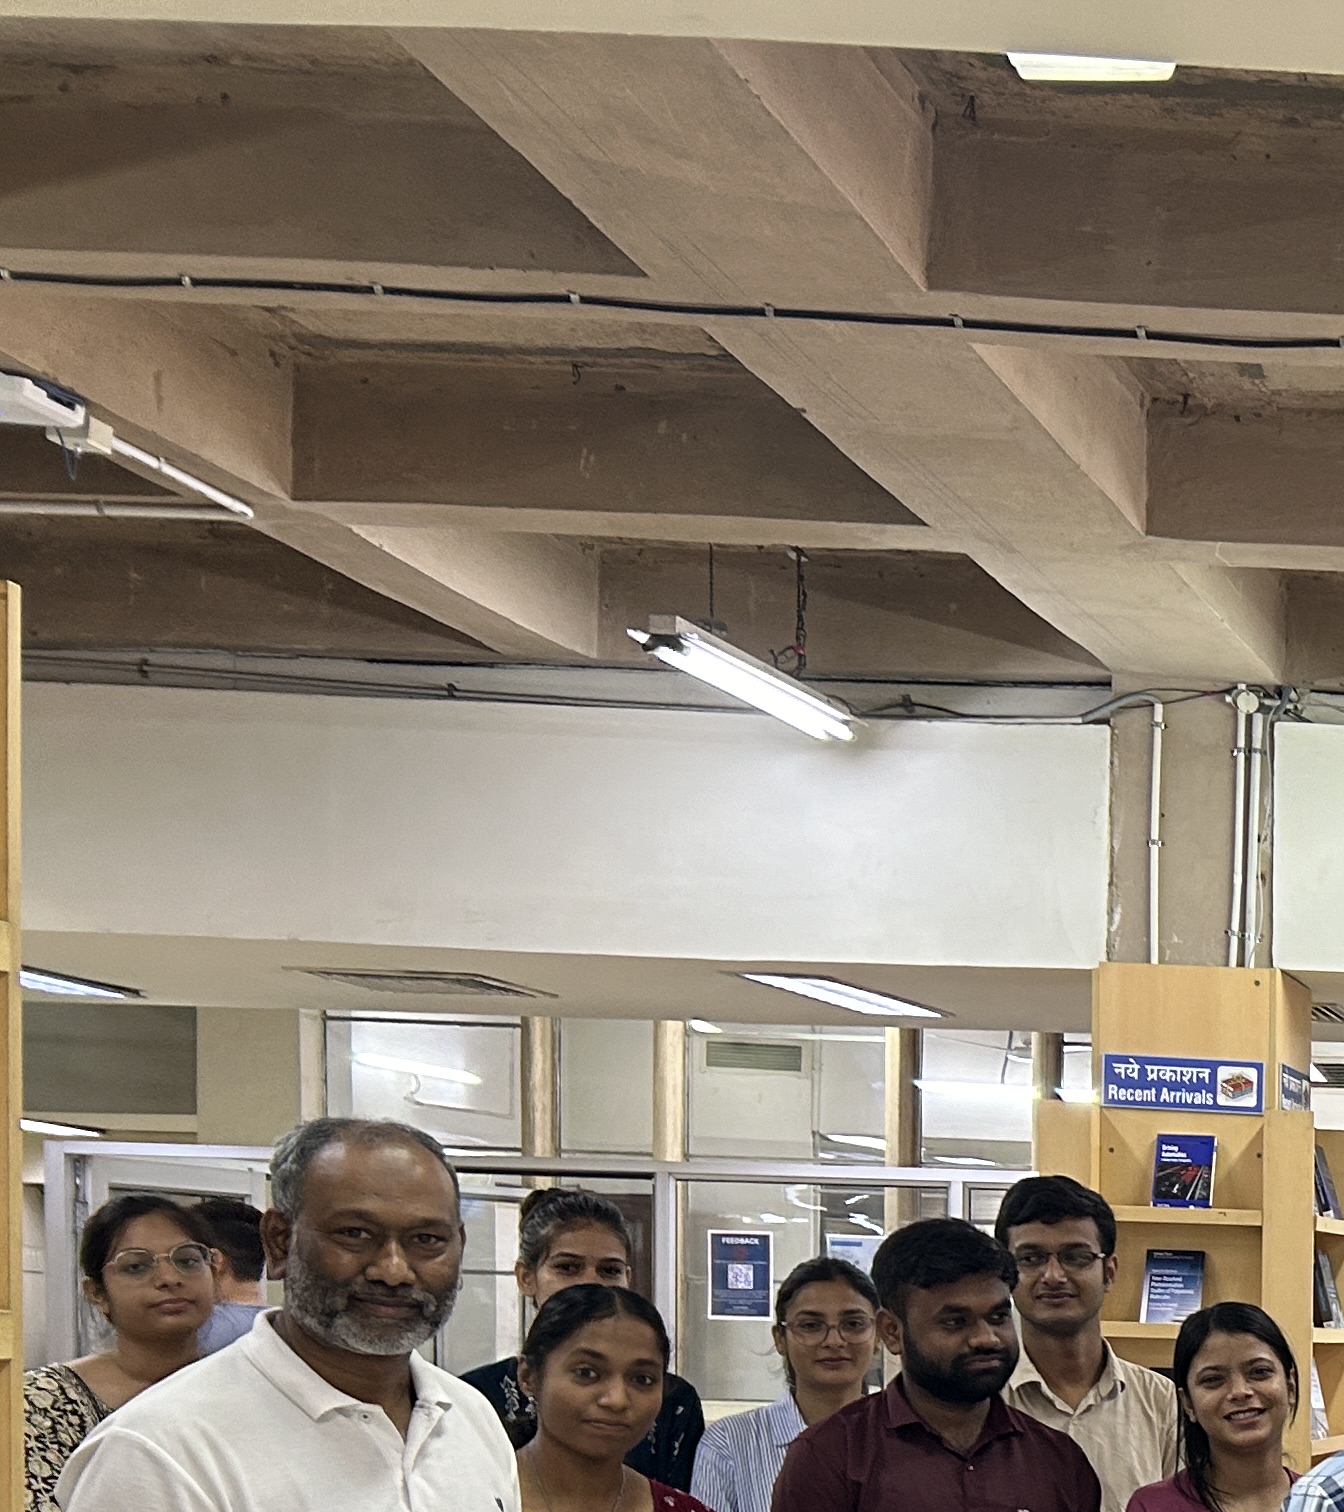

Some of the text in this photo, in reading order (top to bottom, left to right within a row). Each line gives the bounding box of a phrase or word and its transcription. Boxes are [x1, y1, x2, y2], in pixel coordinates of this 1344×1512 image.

[1112, 1058, 1212, 1085] नये प्रकाशन
[1108, 1084, 1214, 1106] Recent Arrivals
[721, 1236, 759, 1246] FEEDBACK
